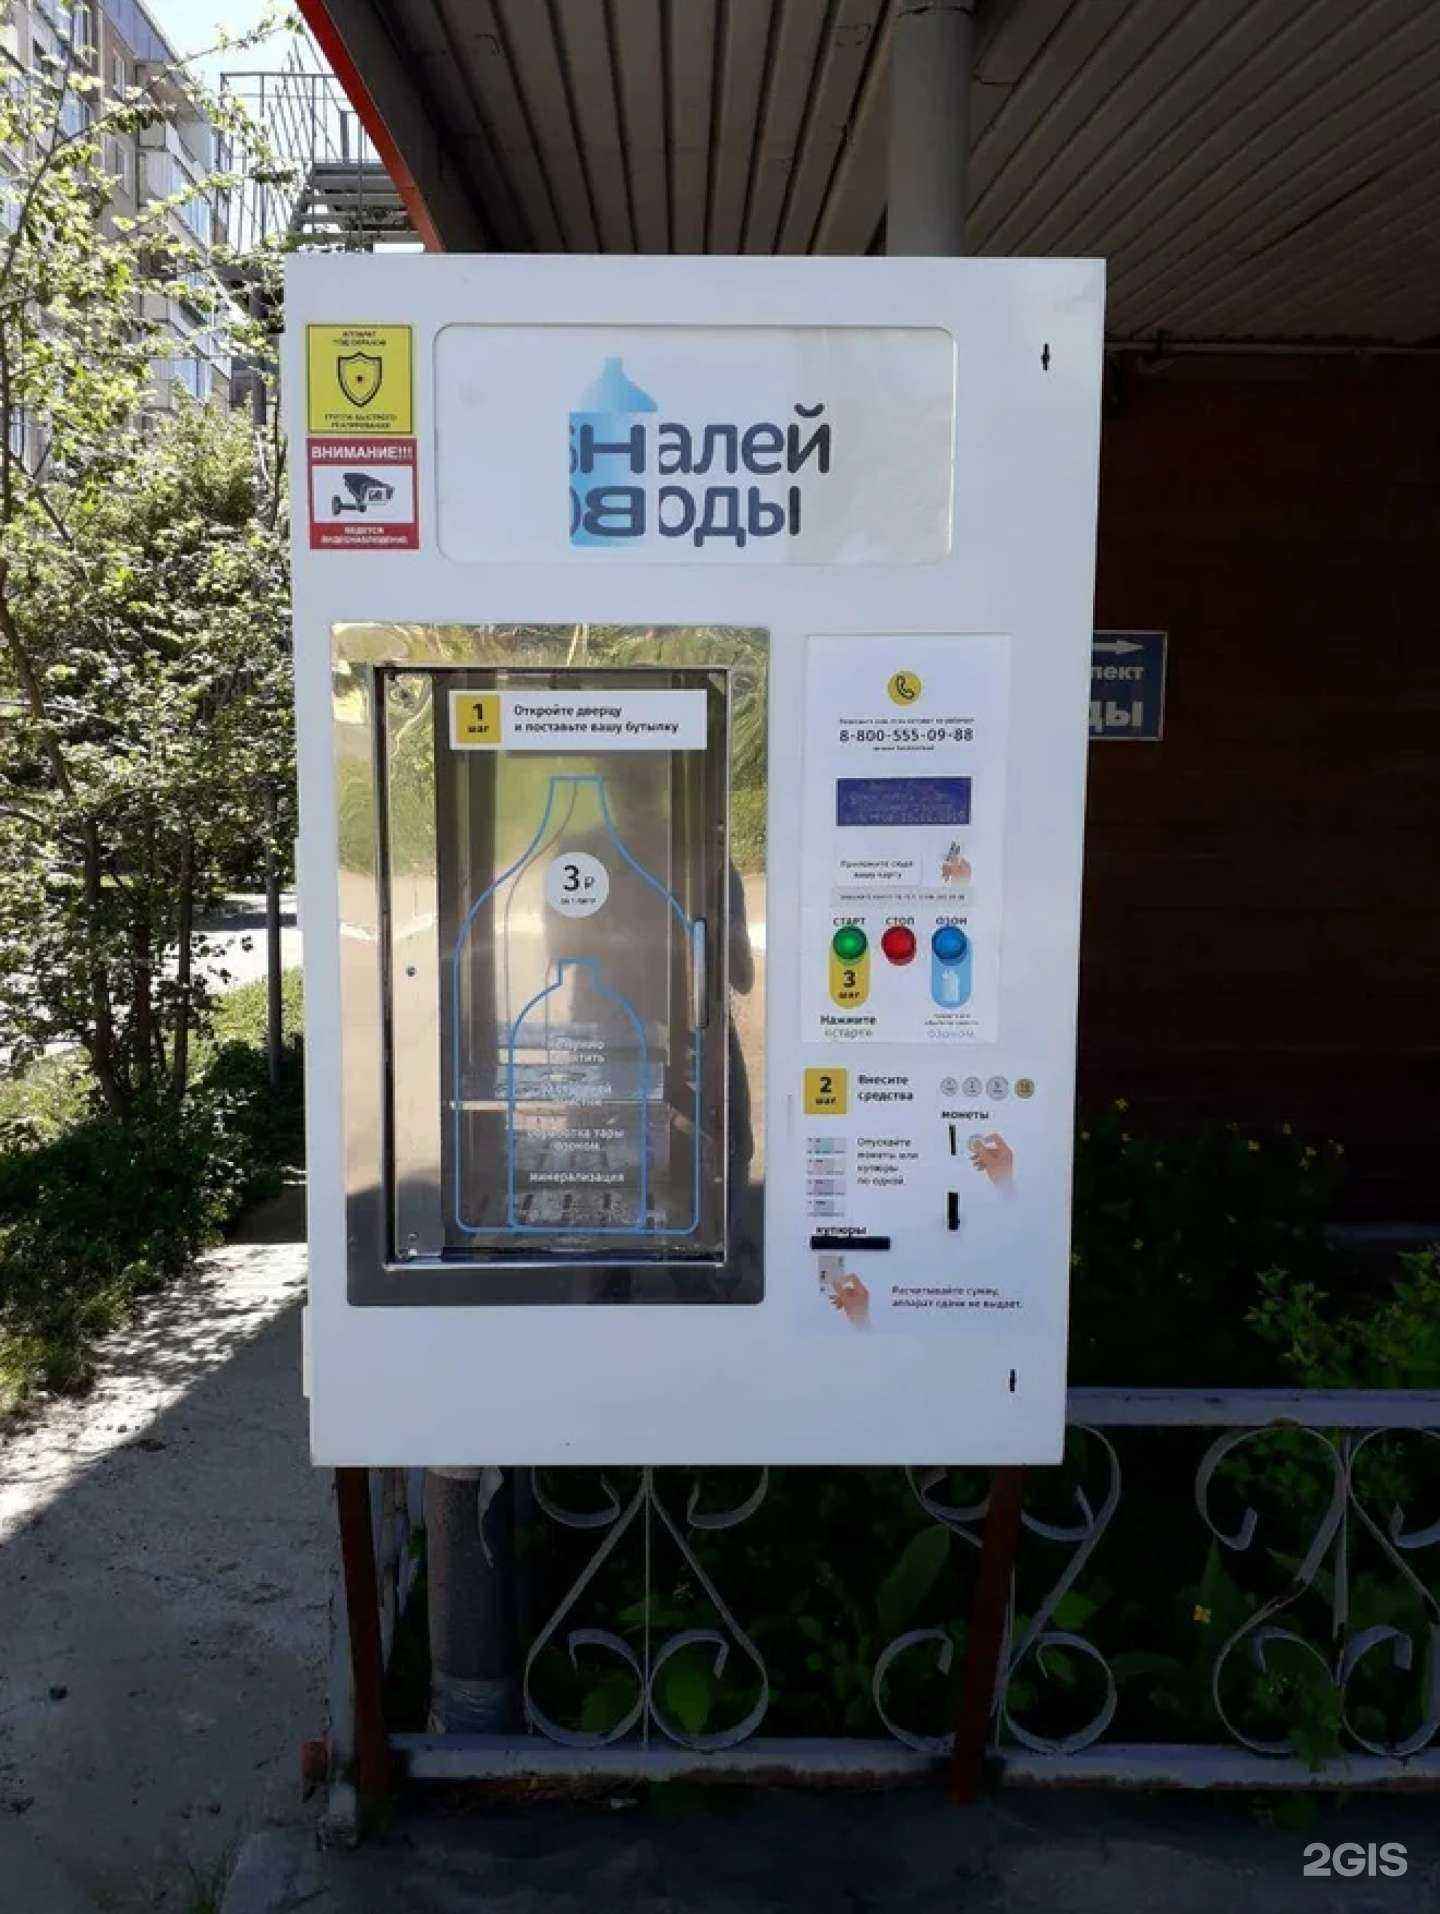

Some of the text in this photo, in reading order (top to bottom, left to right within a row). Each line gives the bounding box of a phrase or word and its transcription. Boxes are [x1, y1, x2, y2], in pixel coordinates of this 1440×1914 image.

[311, 445, 414, 459] ВНИМАНИЕ!!!
[472, 703, 483, 720] 1
[514, 703, 622, 718] Откройте дверцу
[467, 724, 490, 734] шаг
[525, 723, 588, 732] поставьте
[590, 723, 622, 734] вашу
[625, 721, 679, 734] бутылку
[839, 728, 974, 742] 8-800-555-09-88
[562, 864, 580, 892] 3
[885, 916, 915, 926] СТОП
[843, 969, 857, 988] 3
[819, 1076, 833, 1093] 2
[858, 1074, 909, 1085] Внесите
[815, 1097, 837, 1105] шаг
[857, 1091, 914, 1102] средства
[941, 1110, 989, 1119] монеты
